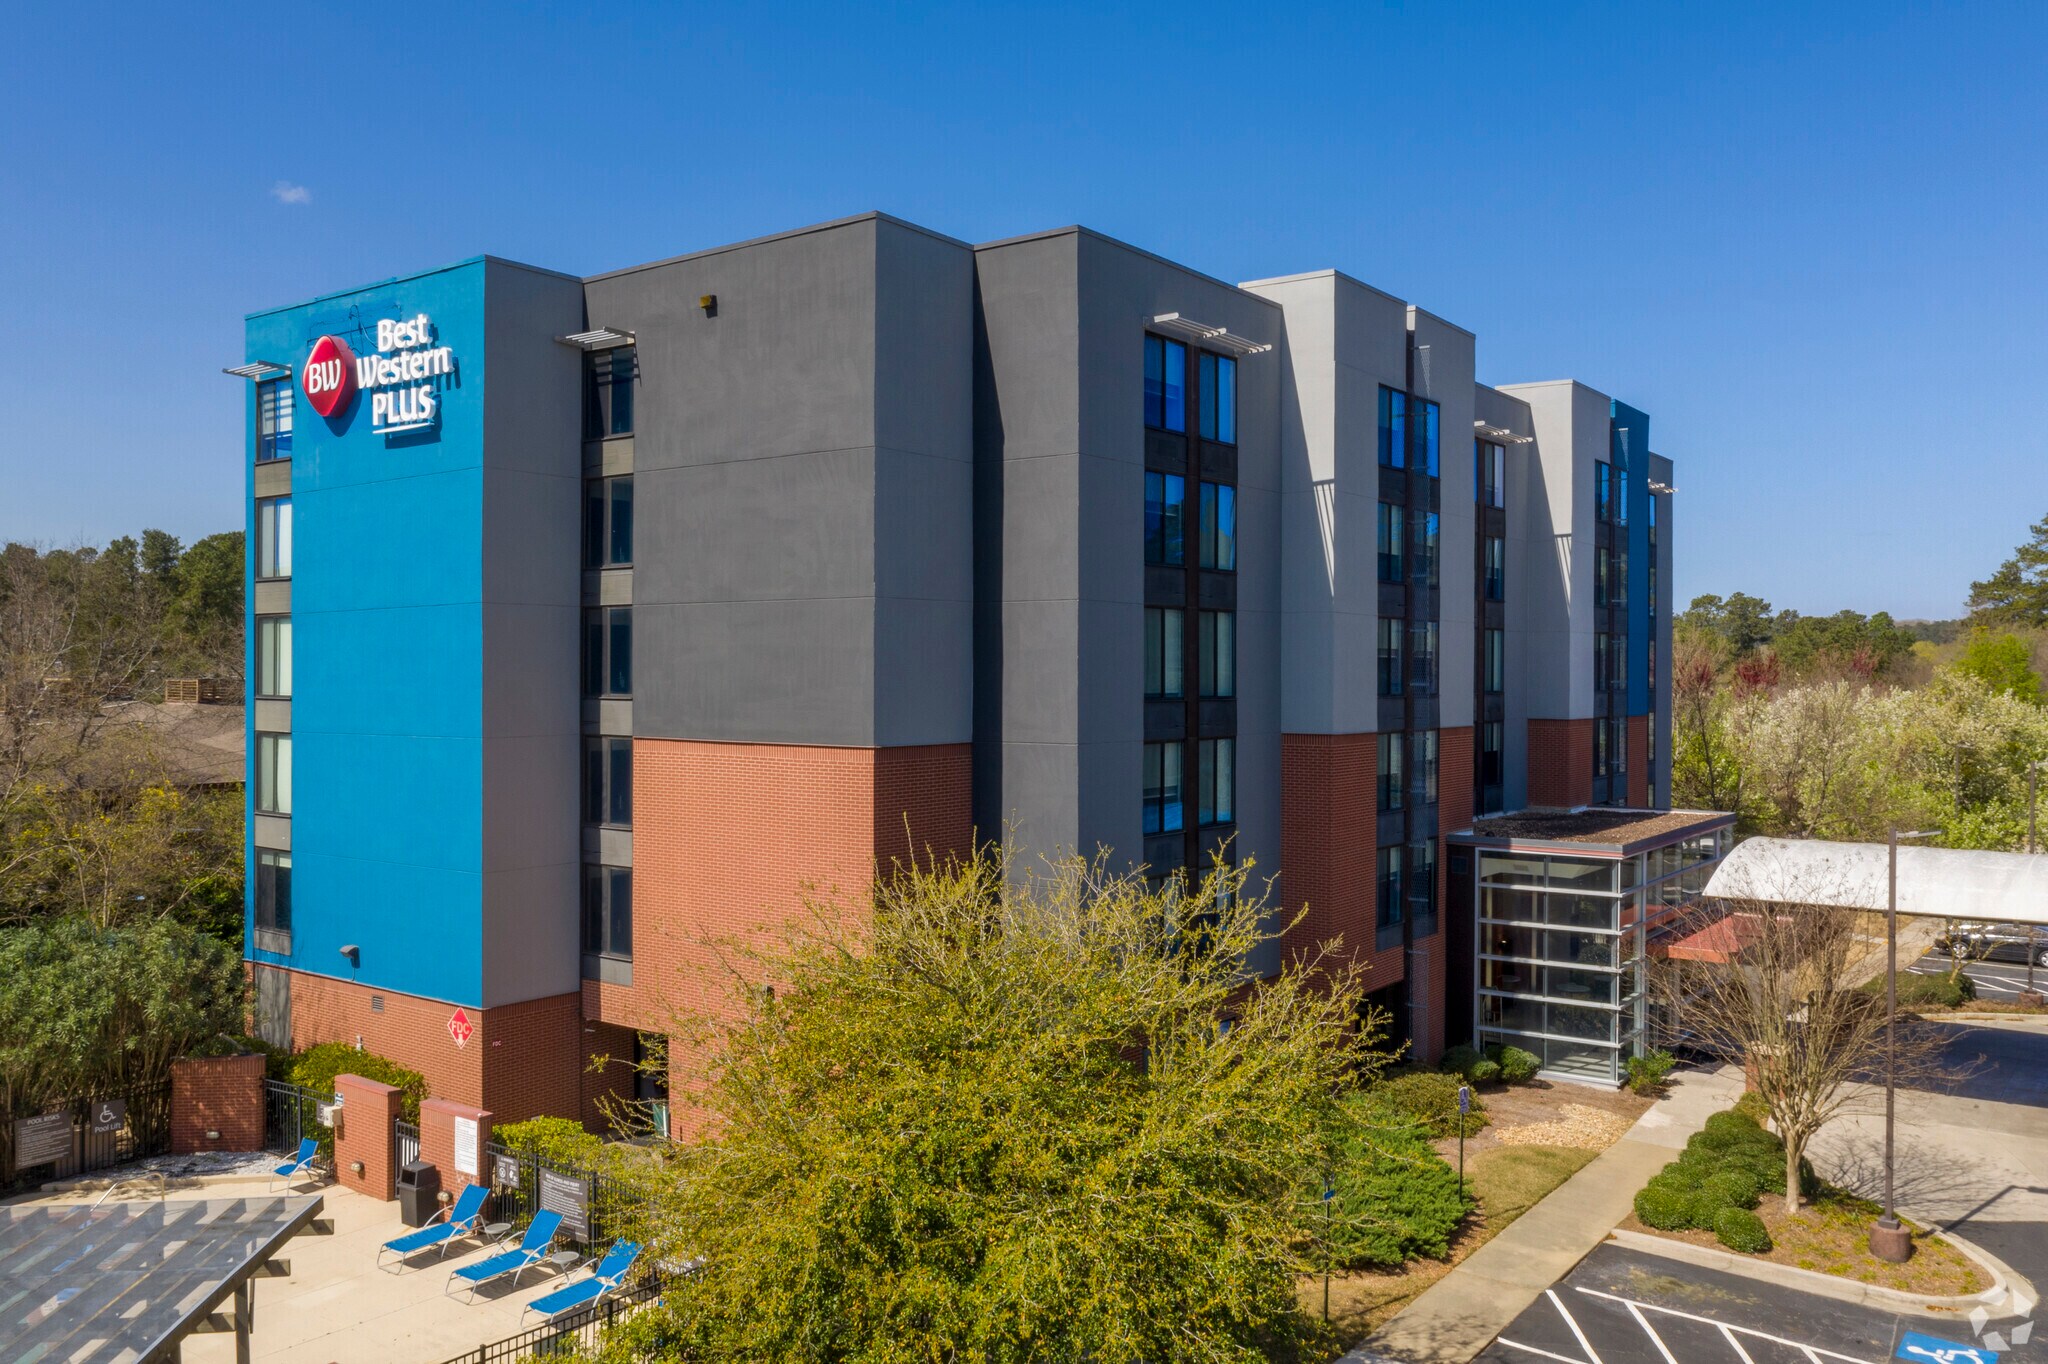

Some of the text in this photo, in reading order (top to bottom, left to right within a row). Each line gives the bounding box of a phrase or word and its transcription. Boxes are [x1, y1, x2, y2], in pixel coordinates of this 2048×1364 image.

[377, 313, 431, 352] Best
[308, 359, 341, 394] BW
[356, 346, 454, 389] Western
[372, 384, 436, 426] PLUS
[451, 1020, 470, 1035] FDC
[27, 1114, 61, 1126] POOL RISKS
[94, 1122, 122, 1133] Pool Lift
